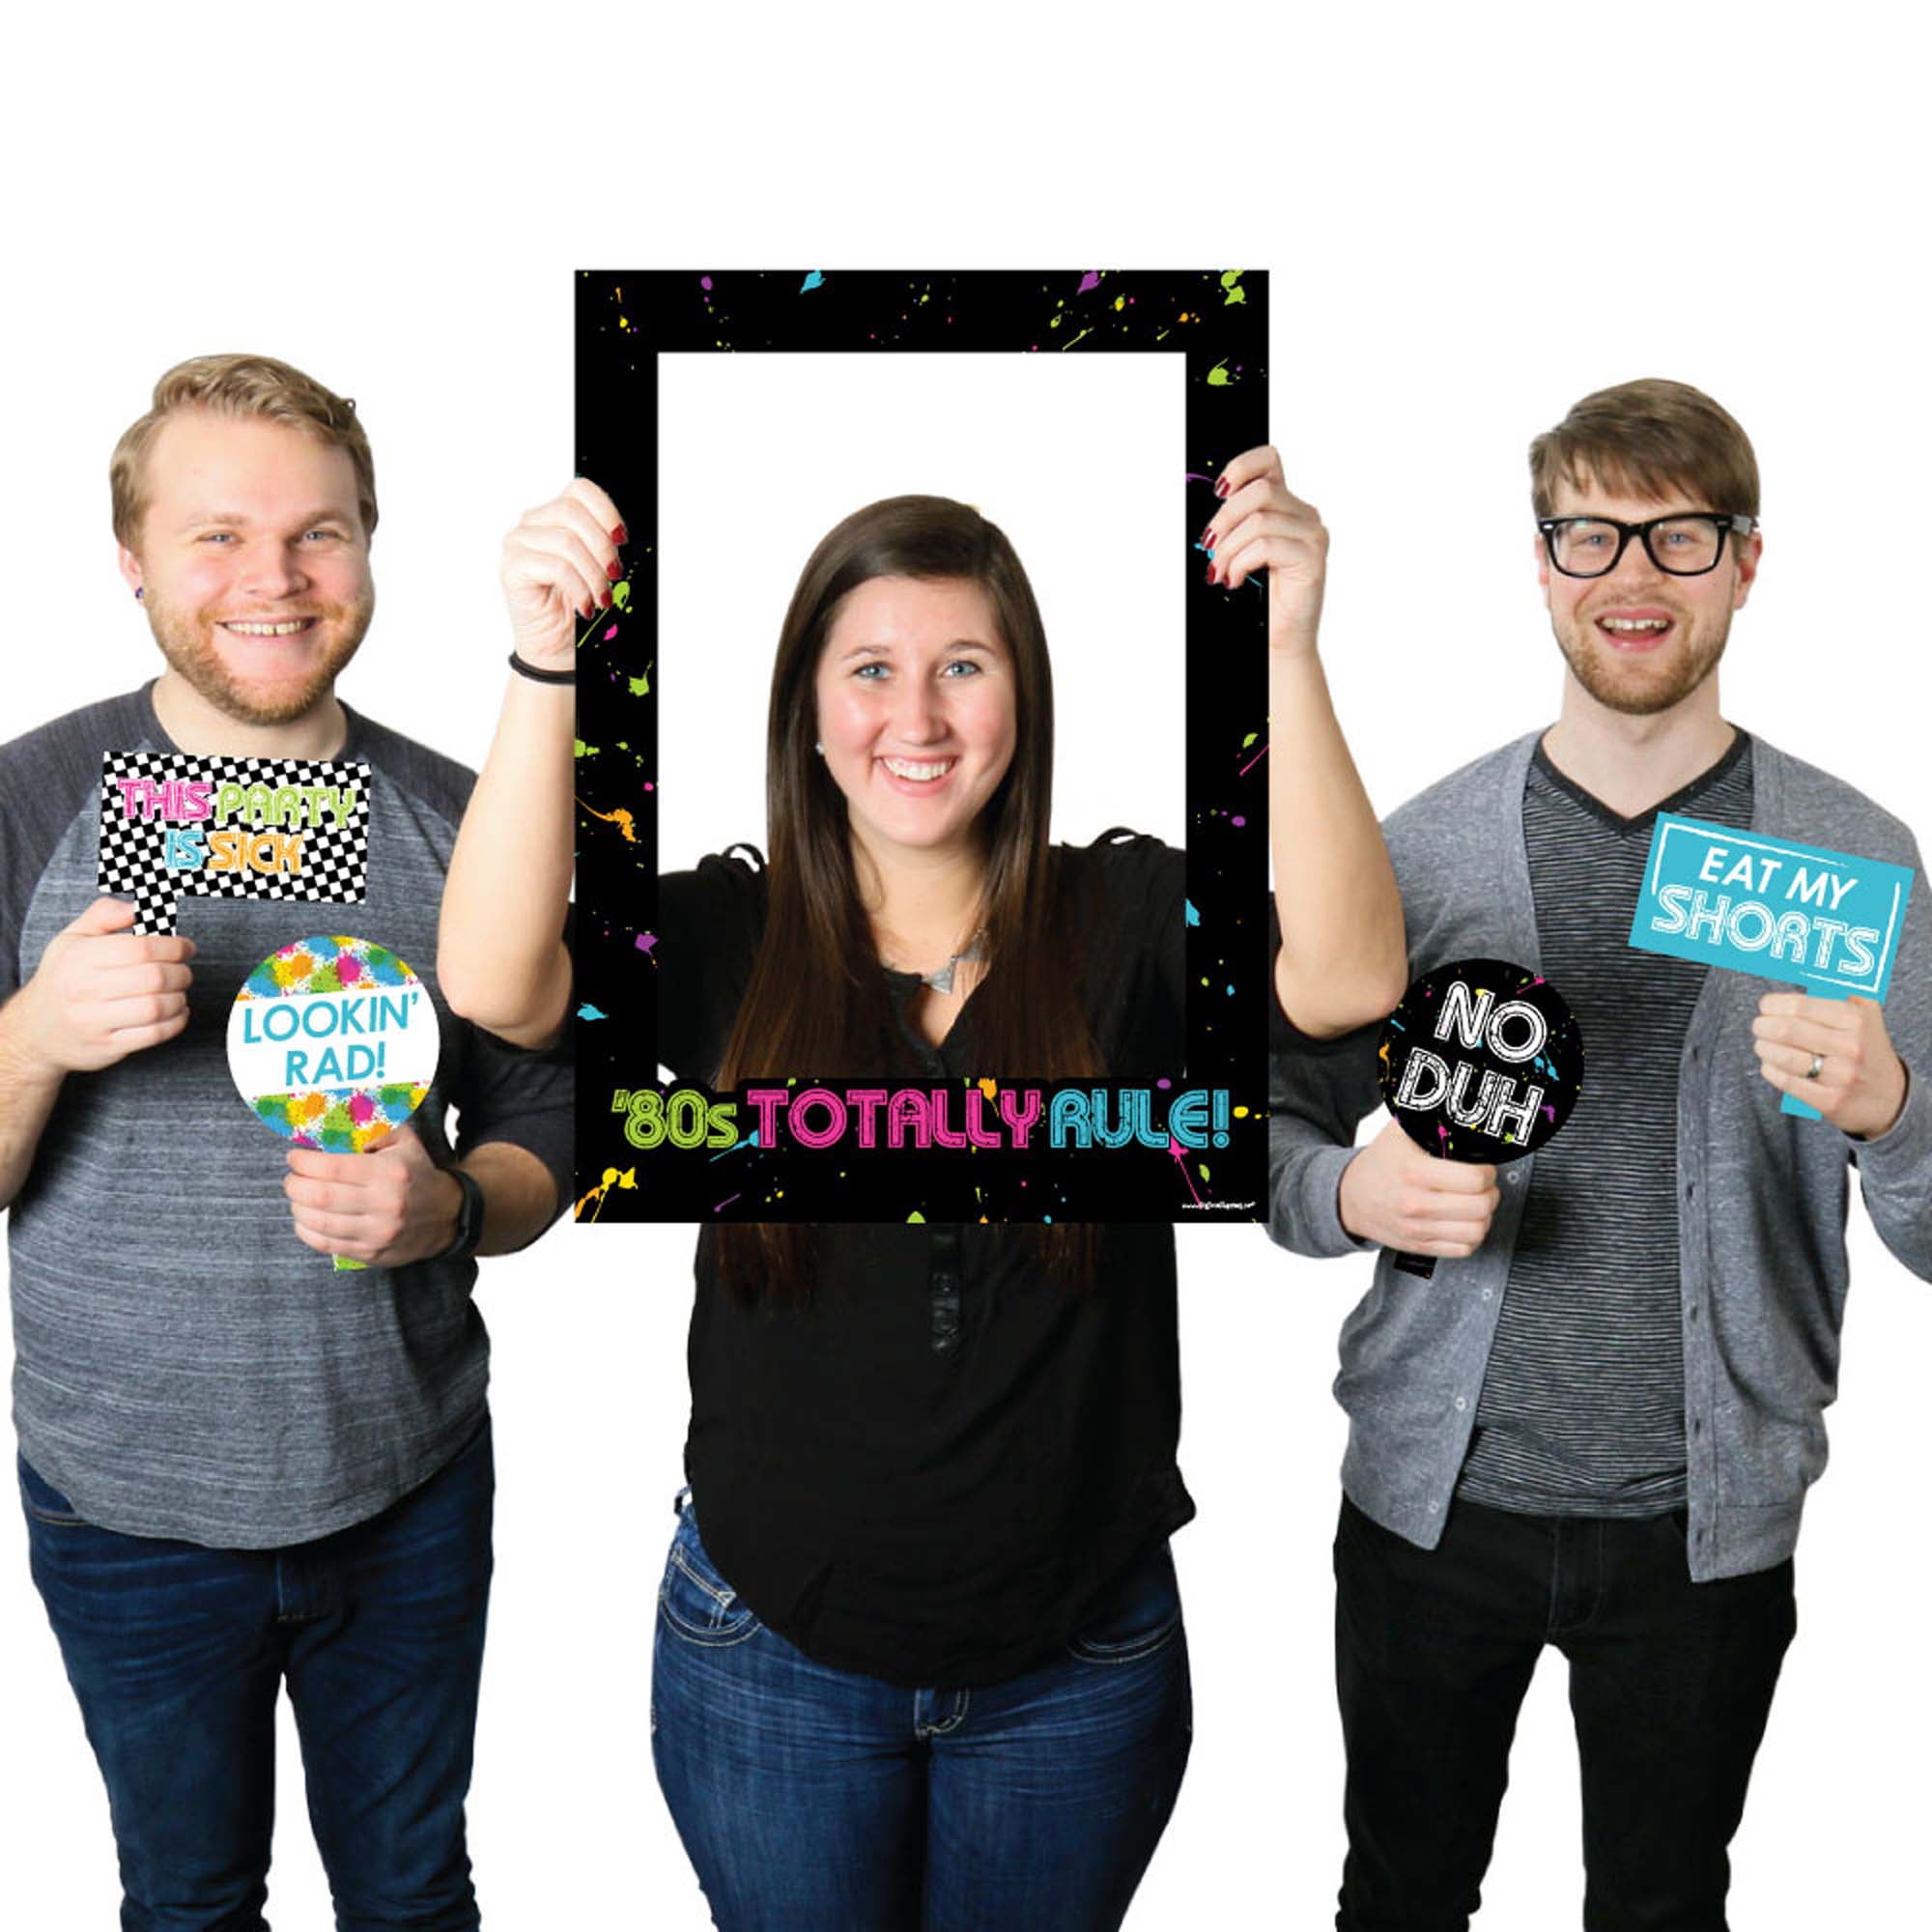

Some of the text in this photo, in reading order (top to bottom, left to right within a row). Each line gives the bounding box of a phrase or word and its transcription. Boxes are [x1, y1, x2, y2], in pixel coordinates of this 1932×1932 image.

[117, 778, 356, 829] THIS PARTY
[164, 829, 303, 874] IS SICK
[1698, 846, 1859, 910] EAT MY
[1650, 884, 1881, 979] SHORTS
[242, 991, 419, 1044] LOOKIN'
[1435, 980, 1547, 1063] NO
[284, 1040, 387, 1087] RAD!
[748, 1089, 1042, 1149] TOTALLY
[1050, 1089, 1231, 1150] RULE!
[1396, 1046, 1545, 1147] DUH
